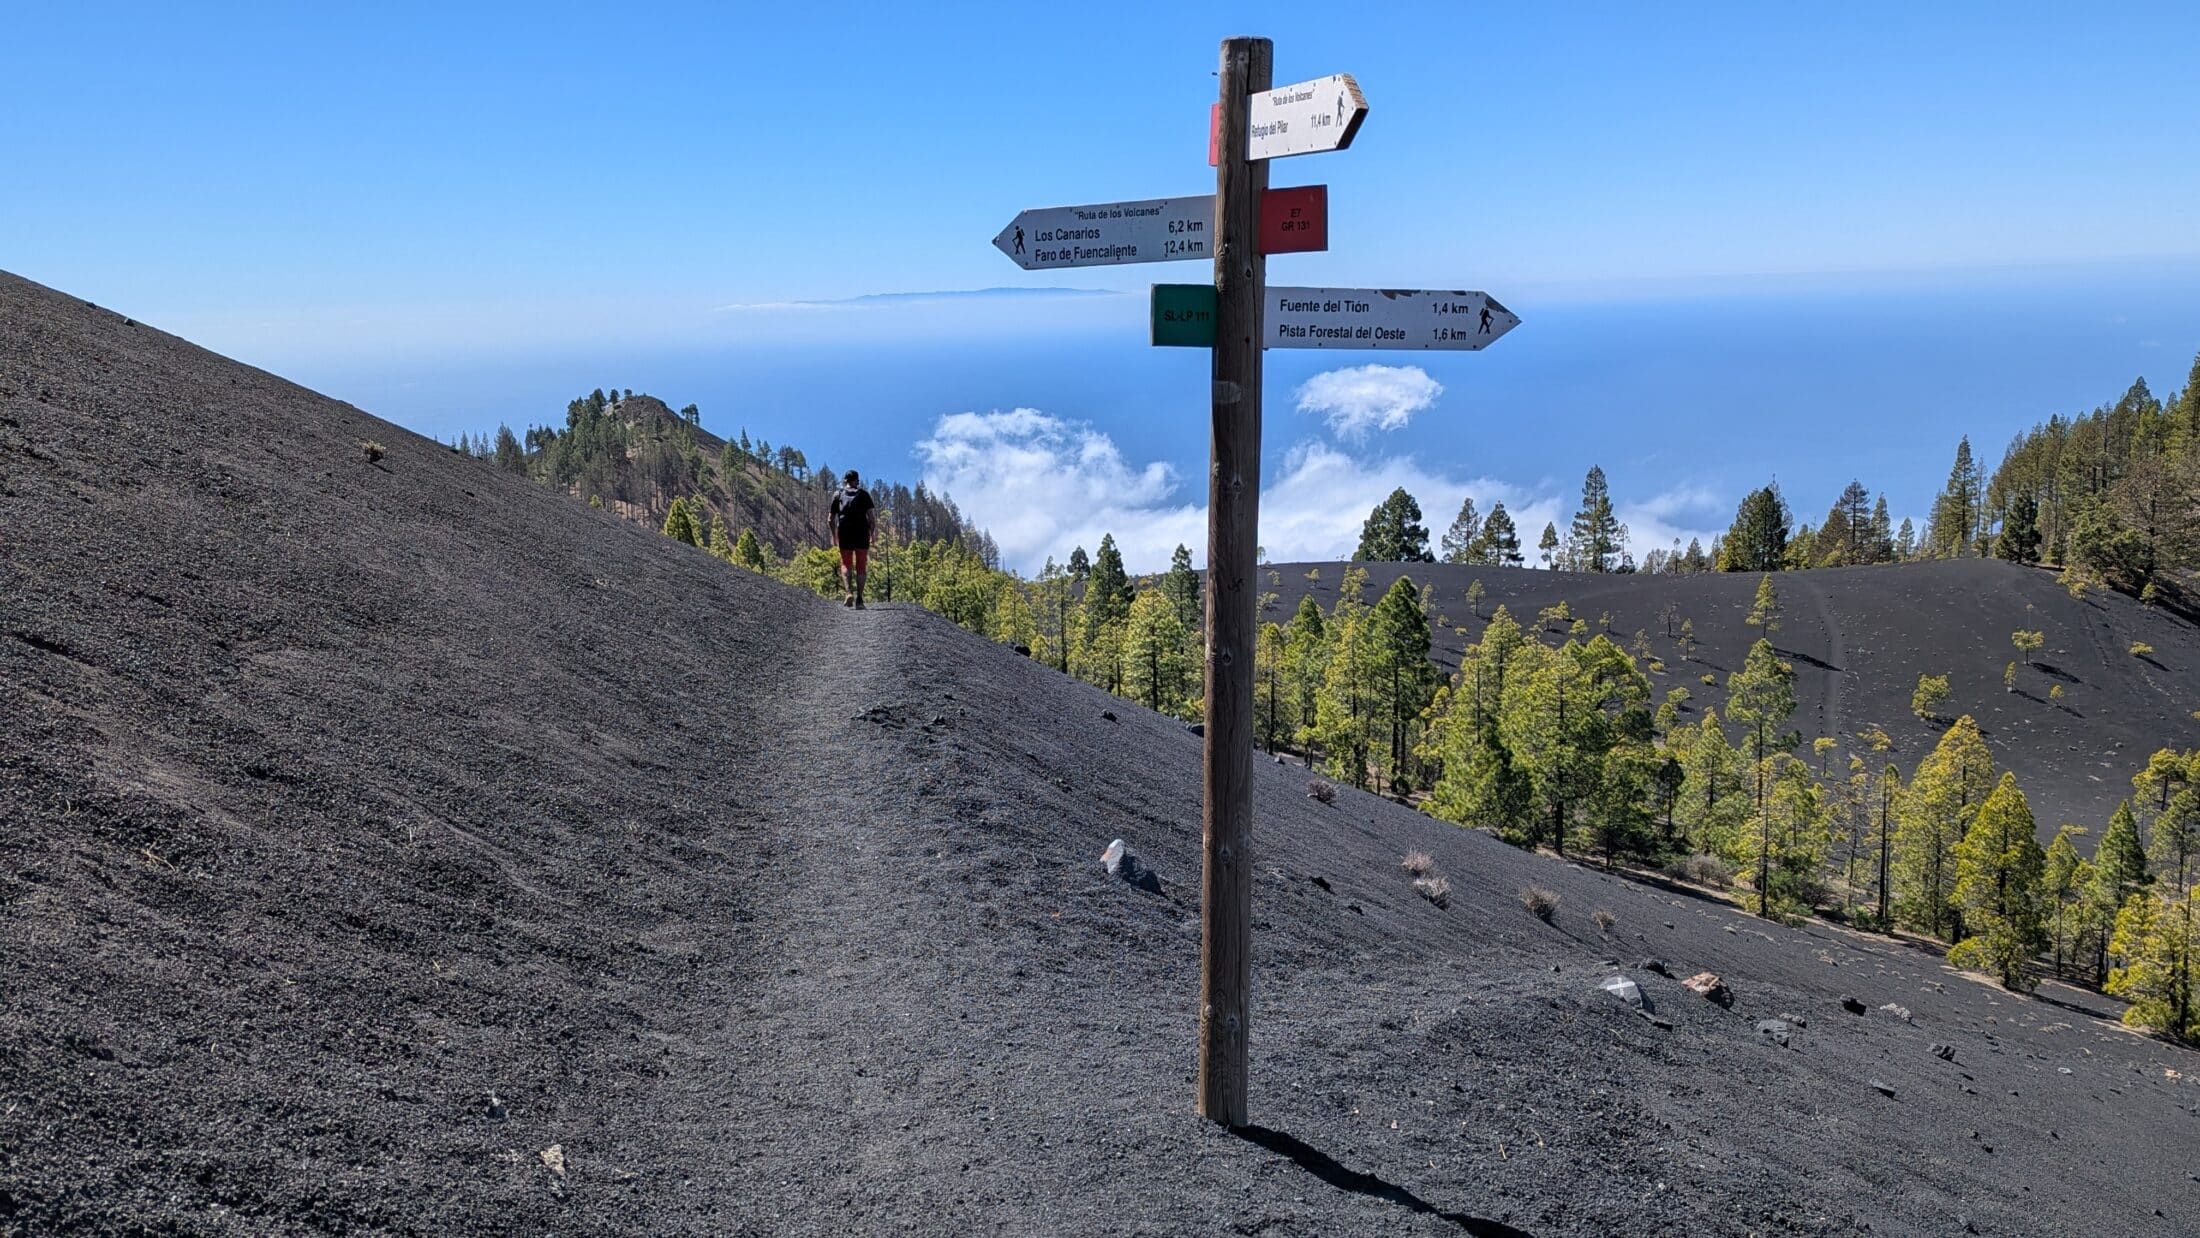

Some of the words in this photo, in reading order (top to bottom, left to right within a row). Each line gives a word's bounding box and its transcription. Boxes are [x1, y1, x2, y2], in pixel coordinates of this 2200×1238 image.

[1283, 94, 1288, 104] de
[1252, 123, 1268, 140] Refugio
[1277, 120, 1288, 134] Pilar
[1311, 113, 1321, 130] 11,4
[1322, 112, 1330, 126] km
[1098, 210, 1108, 219] de
[1110, 209, 1122, 218] los
[1290, 208, 1302, 218] E7
[1035, 230, 1053, 242] Los
[1056, 226, 1100, 240] Canarios
[1168, 220, 1184, 235] 6,2
[1186, 220, 1203, 232] km
[1282, 221, 1294, 232] GR
[1297, 221, 1310, 230] 131
[1035, 248, 1056, 262] Faro
[1059, 247, 1072, 260] de
[1074, 244, 1137, 260] Fuencaliente
[1164, 240, 1184, 254] 12,4
[1188, 238, 1203, 252] km
[1280, 299, 1320, 312] Fuente
[1323, 300, 1340, 312] del
[1344, 300, 1370, 313] Tión
[1432, 302, 1448, 316] 1,4
[1452, 302, 1468, 314] km
[1280, 324, 1306, 338] Pista
[1309, 325, 1352, 338] Forestal
[1356, 326, 1372, 339] del
[1374, 327, 1406, 340] Oeste
[1433, 328, 1448, 342] 1,6
[1450, 328, 1466, 340] km
